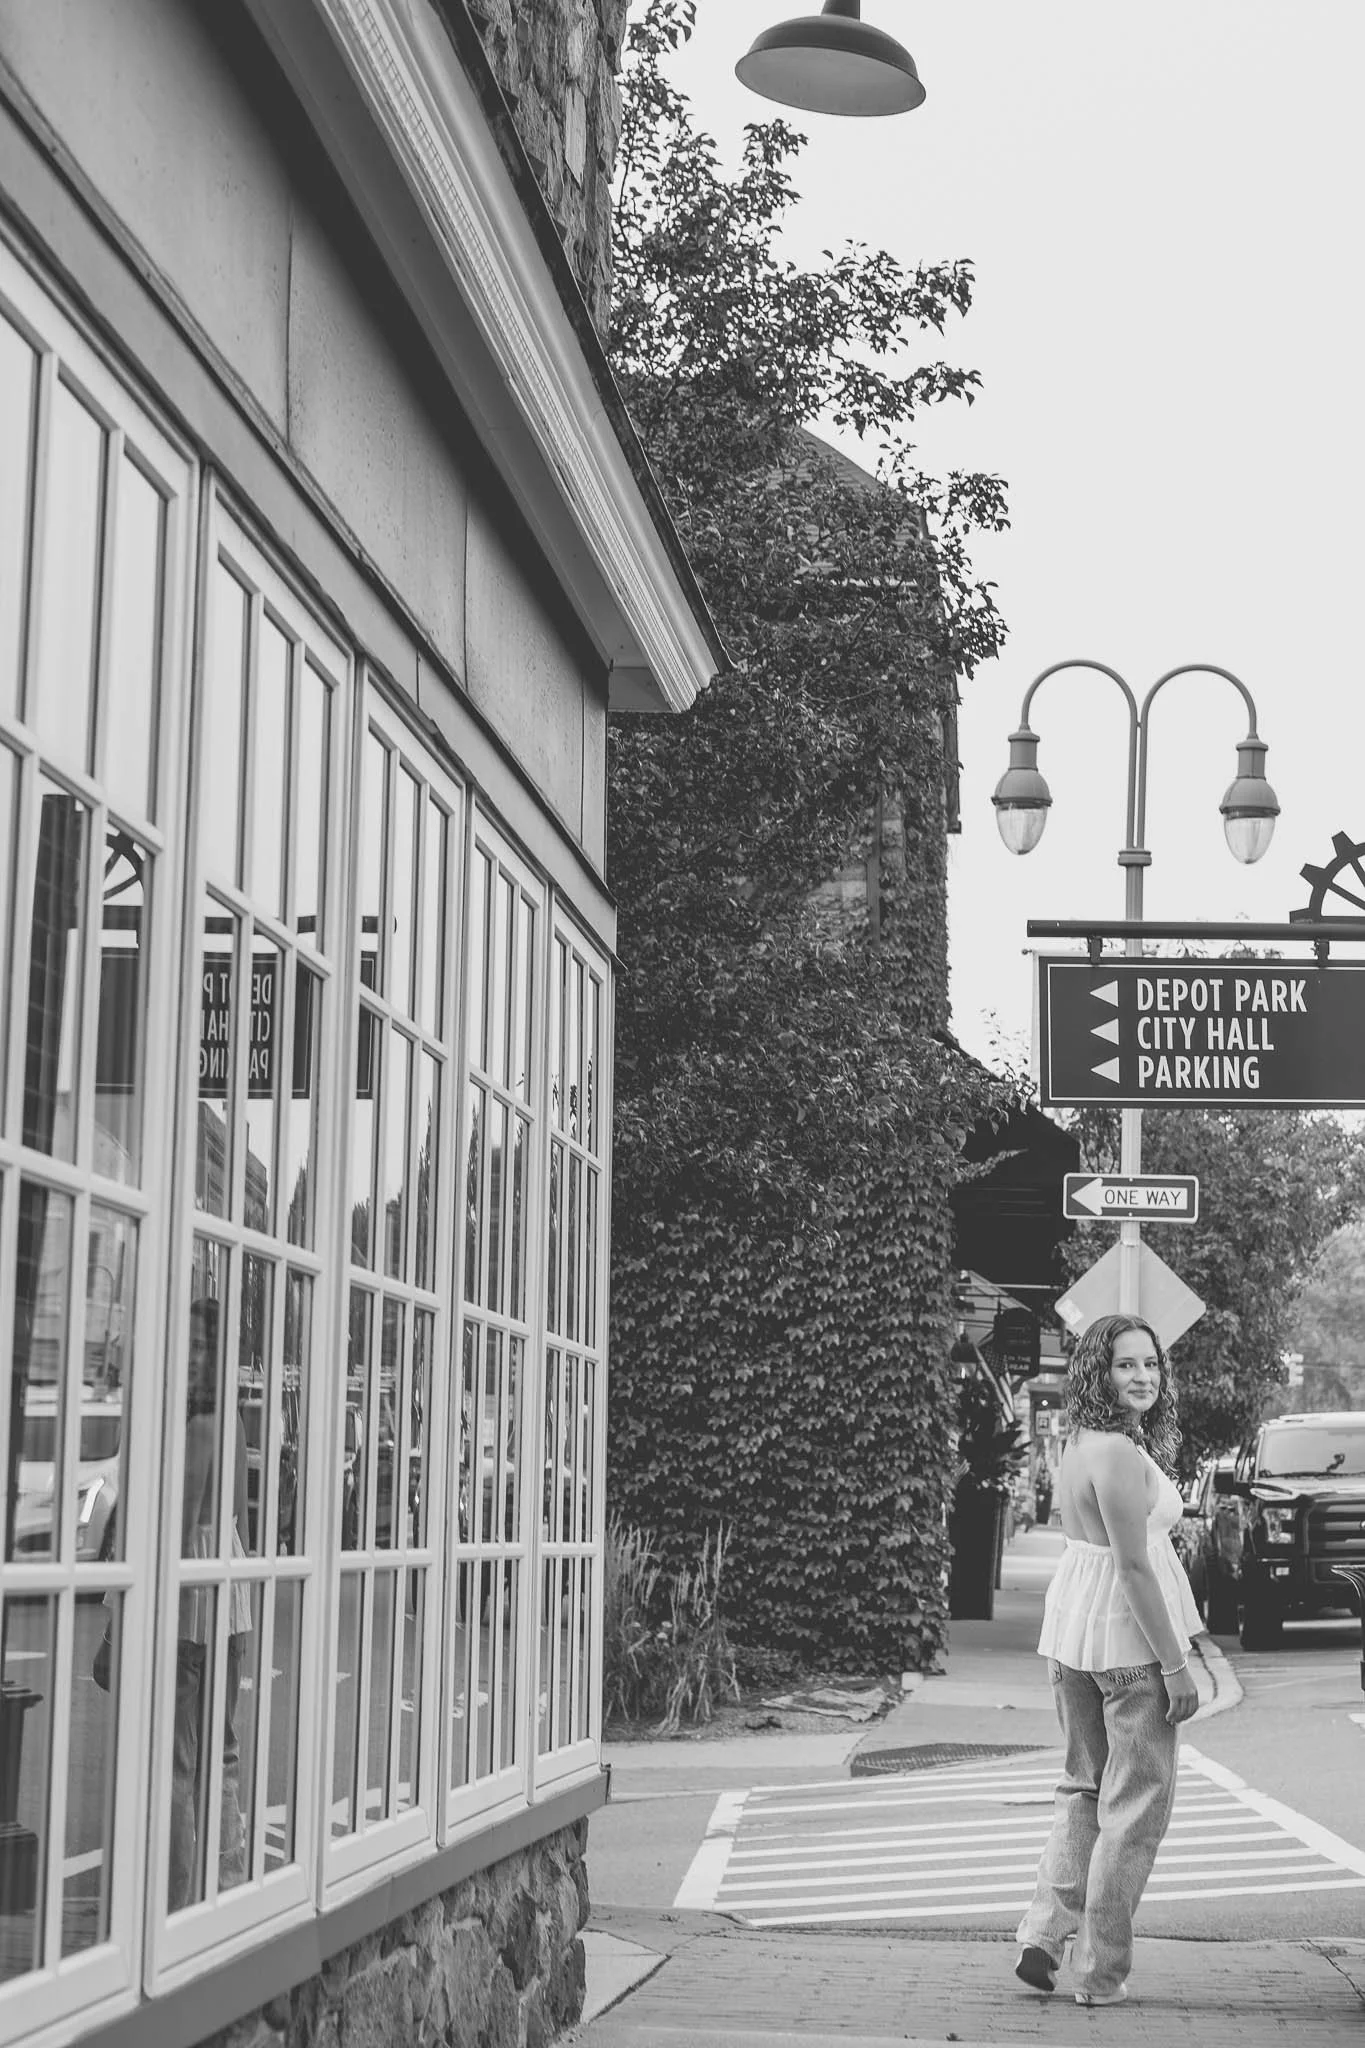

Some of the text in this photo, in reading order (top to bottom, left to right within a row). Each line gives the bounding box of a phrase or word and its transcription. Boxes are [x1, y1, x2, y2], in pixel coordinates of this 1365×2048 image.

[1137, 978, 1307, 1012] DEPOT PARK
[1137, 1016, 1274, 1050] CITY HALL
[1138, 1055, 1260, 1089] PARKING
[1104, 1189, 1181, 1206] ONE WAY
